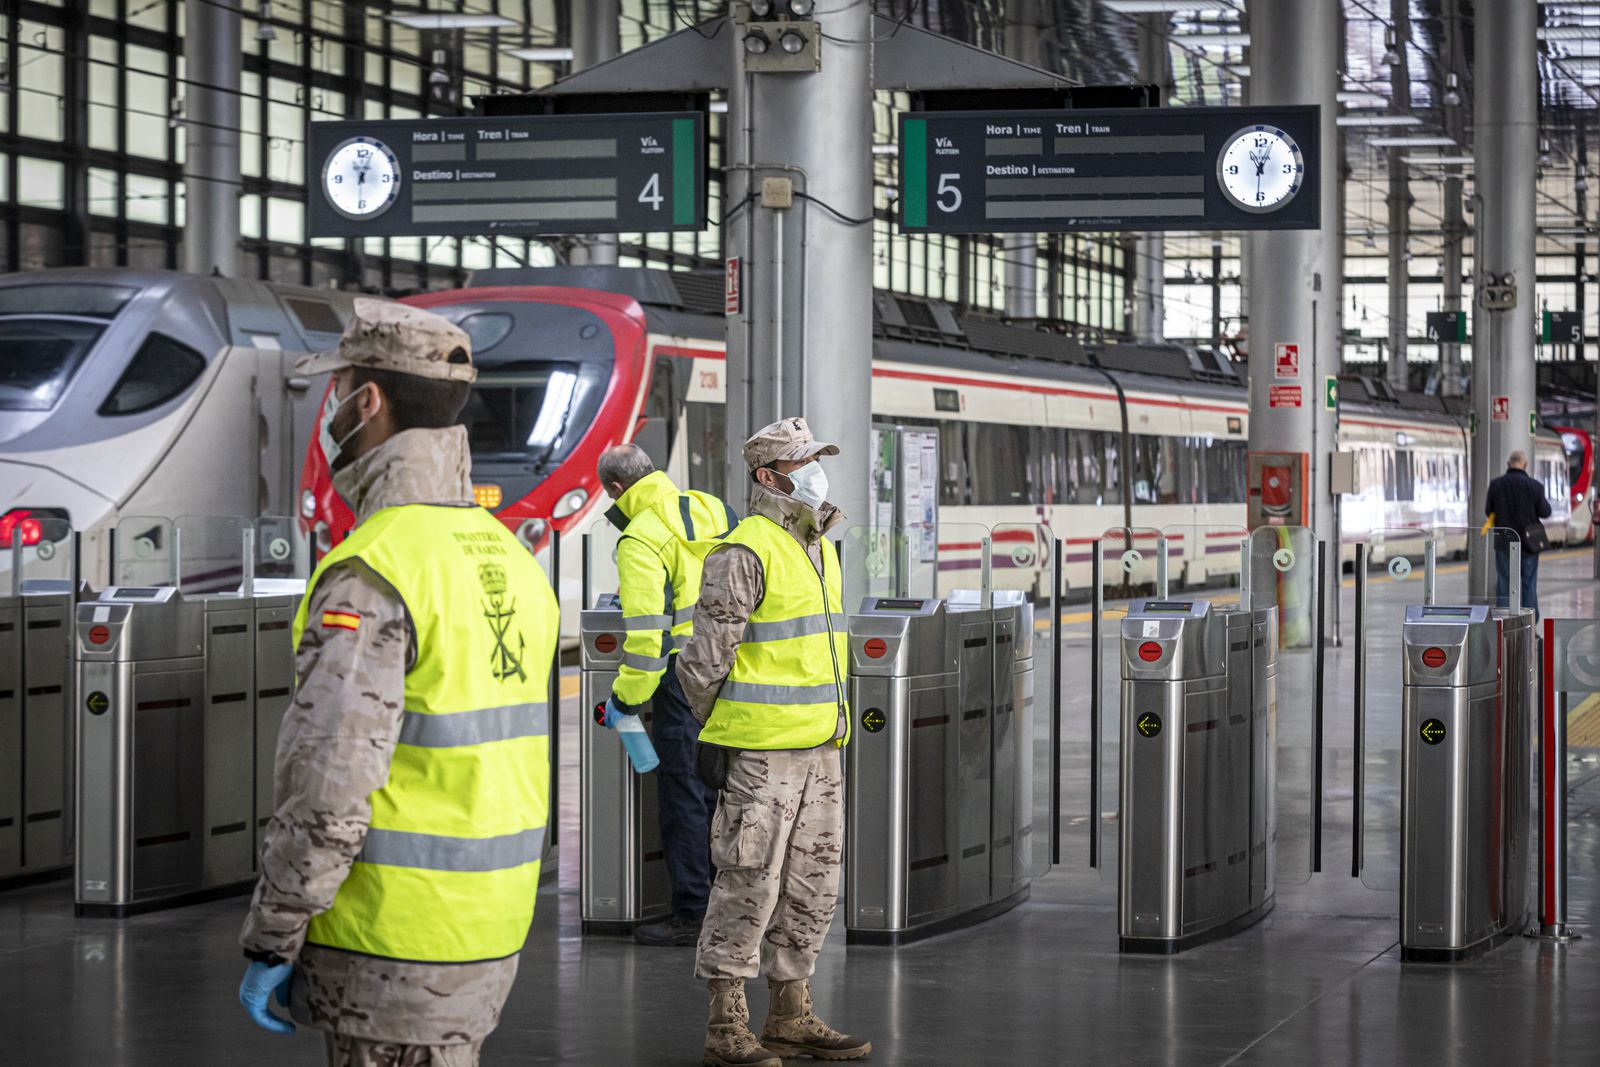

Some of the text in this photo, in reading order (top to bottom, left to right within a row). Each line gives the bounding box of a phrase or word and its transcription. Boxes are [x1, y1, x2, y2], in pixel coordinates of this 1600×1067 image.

[987, 124, 1042, 135] Hora TIME
[1056, 123, 1111, 134] Tren TRAIN
[413, 132, 438, 141] Hora
[477, 130, 502, 139] Tren
[1254, 138, 1268, 148] 12
[357, 150, 369, 158] 12
[986, 165, 1029, 175] Destino
[1229, 165, 1239, 175] 9
[1282, 164, 1292, 174] 3
[334, 175, 343, 184] 9
[382, 174, 390, 183] 3
[413, 170, 453, 180] Destino
[638, 173, 664, 211] 4
[936, 173, 962, 213] 5
[1256, 192, 1265, 202] 6
[1428, 325, 1439, 342] 4
[1571, 325, 1580, 343] 5
